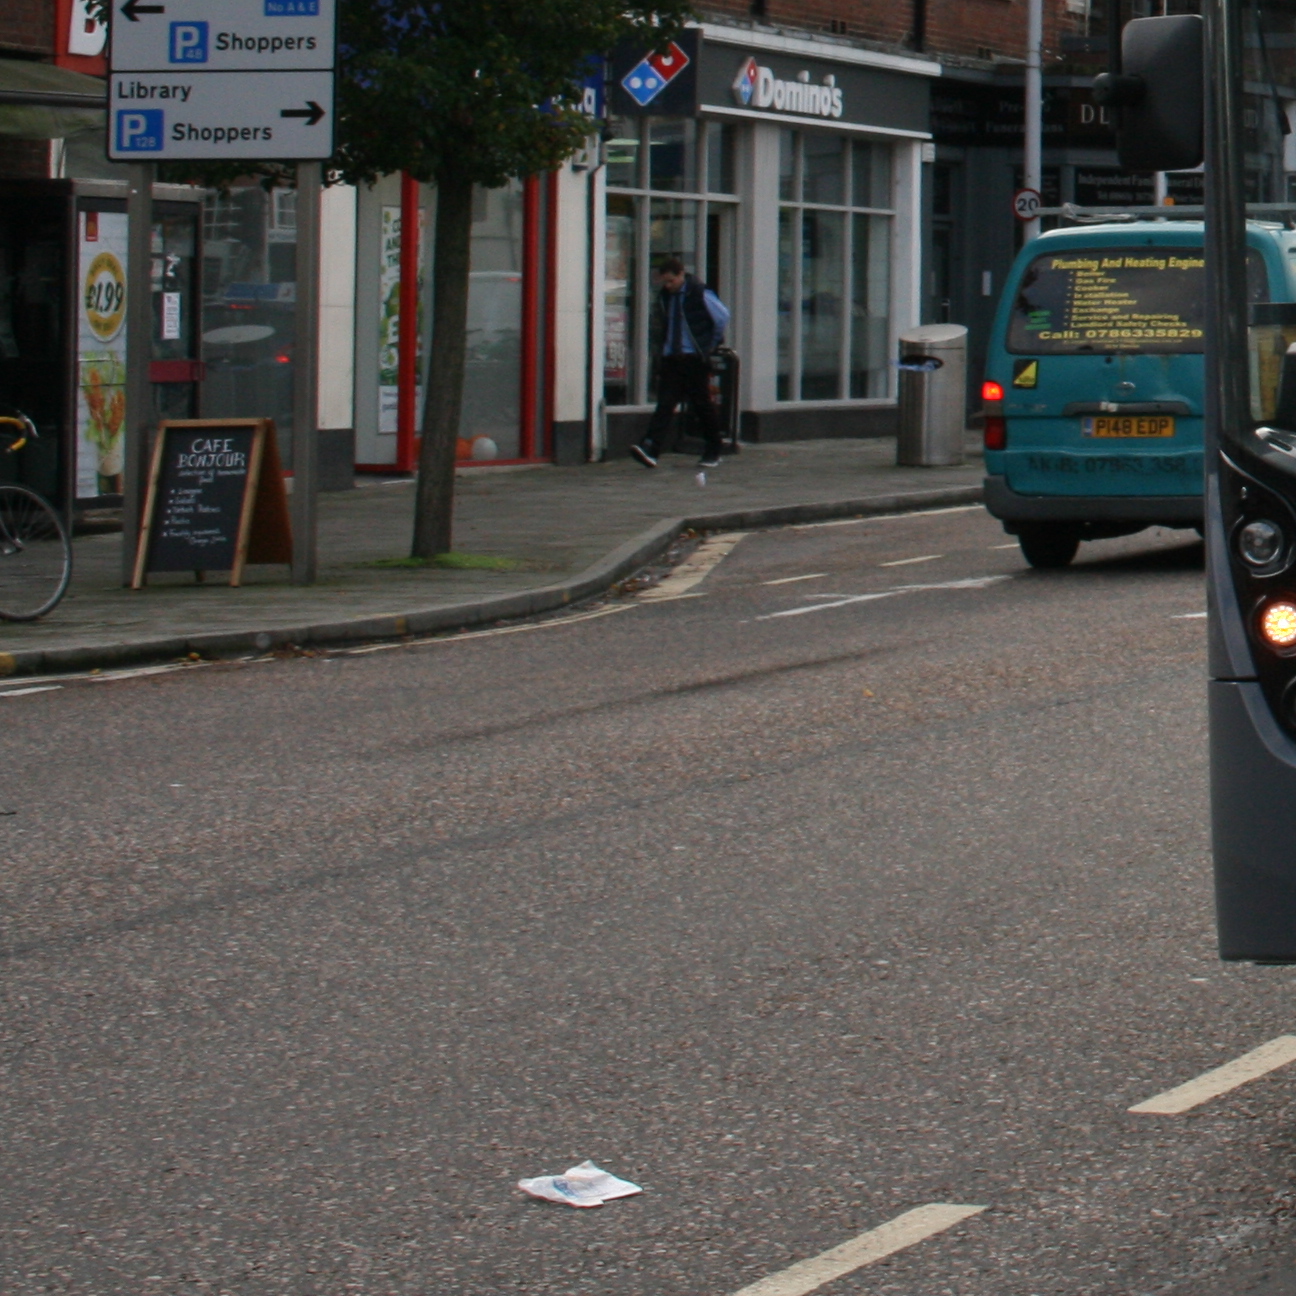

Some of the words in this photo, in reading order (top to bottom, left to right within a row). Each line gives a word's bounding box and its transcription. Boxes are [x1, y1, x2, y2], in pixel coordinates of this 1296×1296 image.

[175, 25, 200, 60] P
[215, 33, 317, 53] Shoppers
[117, 81, 192, 102] Library
[752, 65, 843, 118] Domino's
[122, 114, 147, 148] P
[172, 123, 273, 144] Shoppers
[1017, 197, 1039, 211] 20
[1052, 258, 1099, 272] Plumbing
[1102, 257, 1122, 268] And
[1125, 256, 1166, 270] Heating
[1072, 307, 1120, 315] Exchange
[1132, 313, 1179, 322] Repairing
[1116, 320, 1147, 328] Safety
[1039, 330, 1079, 340] Call:
[1096, 419, 1132, 435] P148
[1137, 419, 1169, 435] EDP
[191, 438, 233, 453] CAFE
[177, 452, 245, 468] BONJOUR
